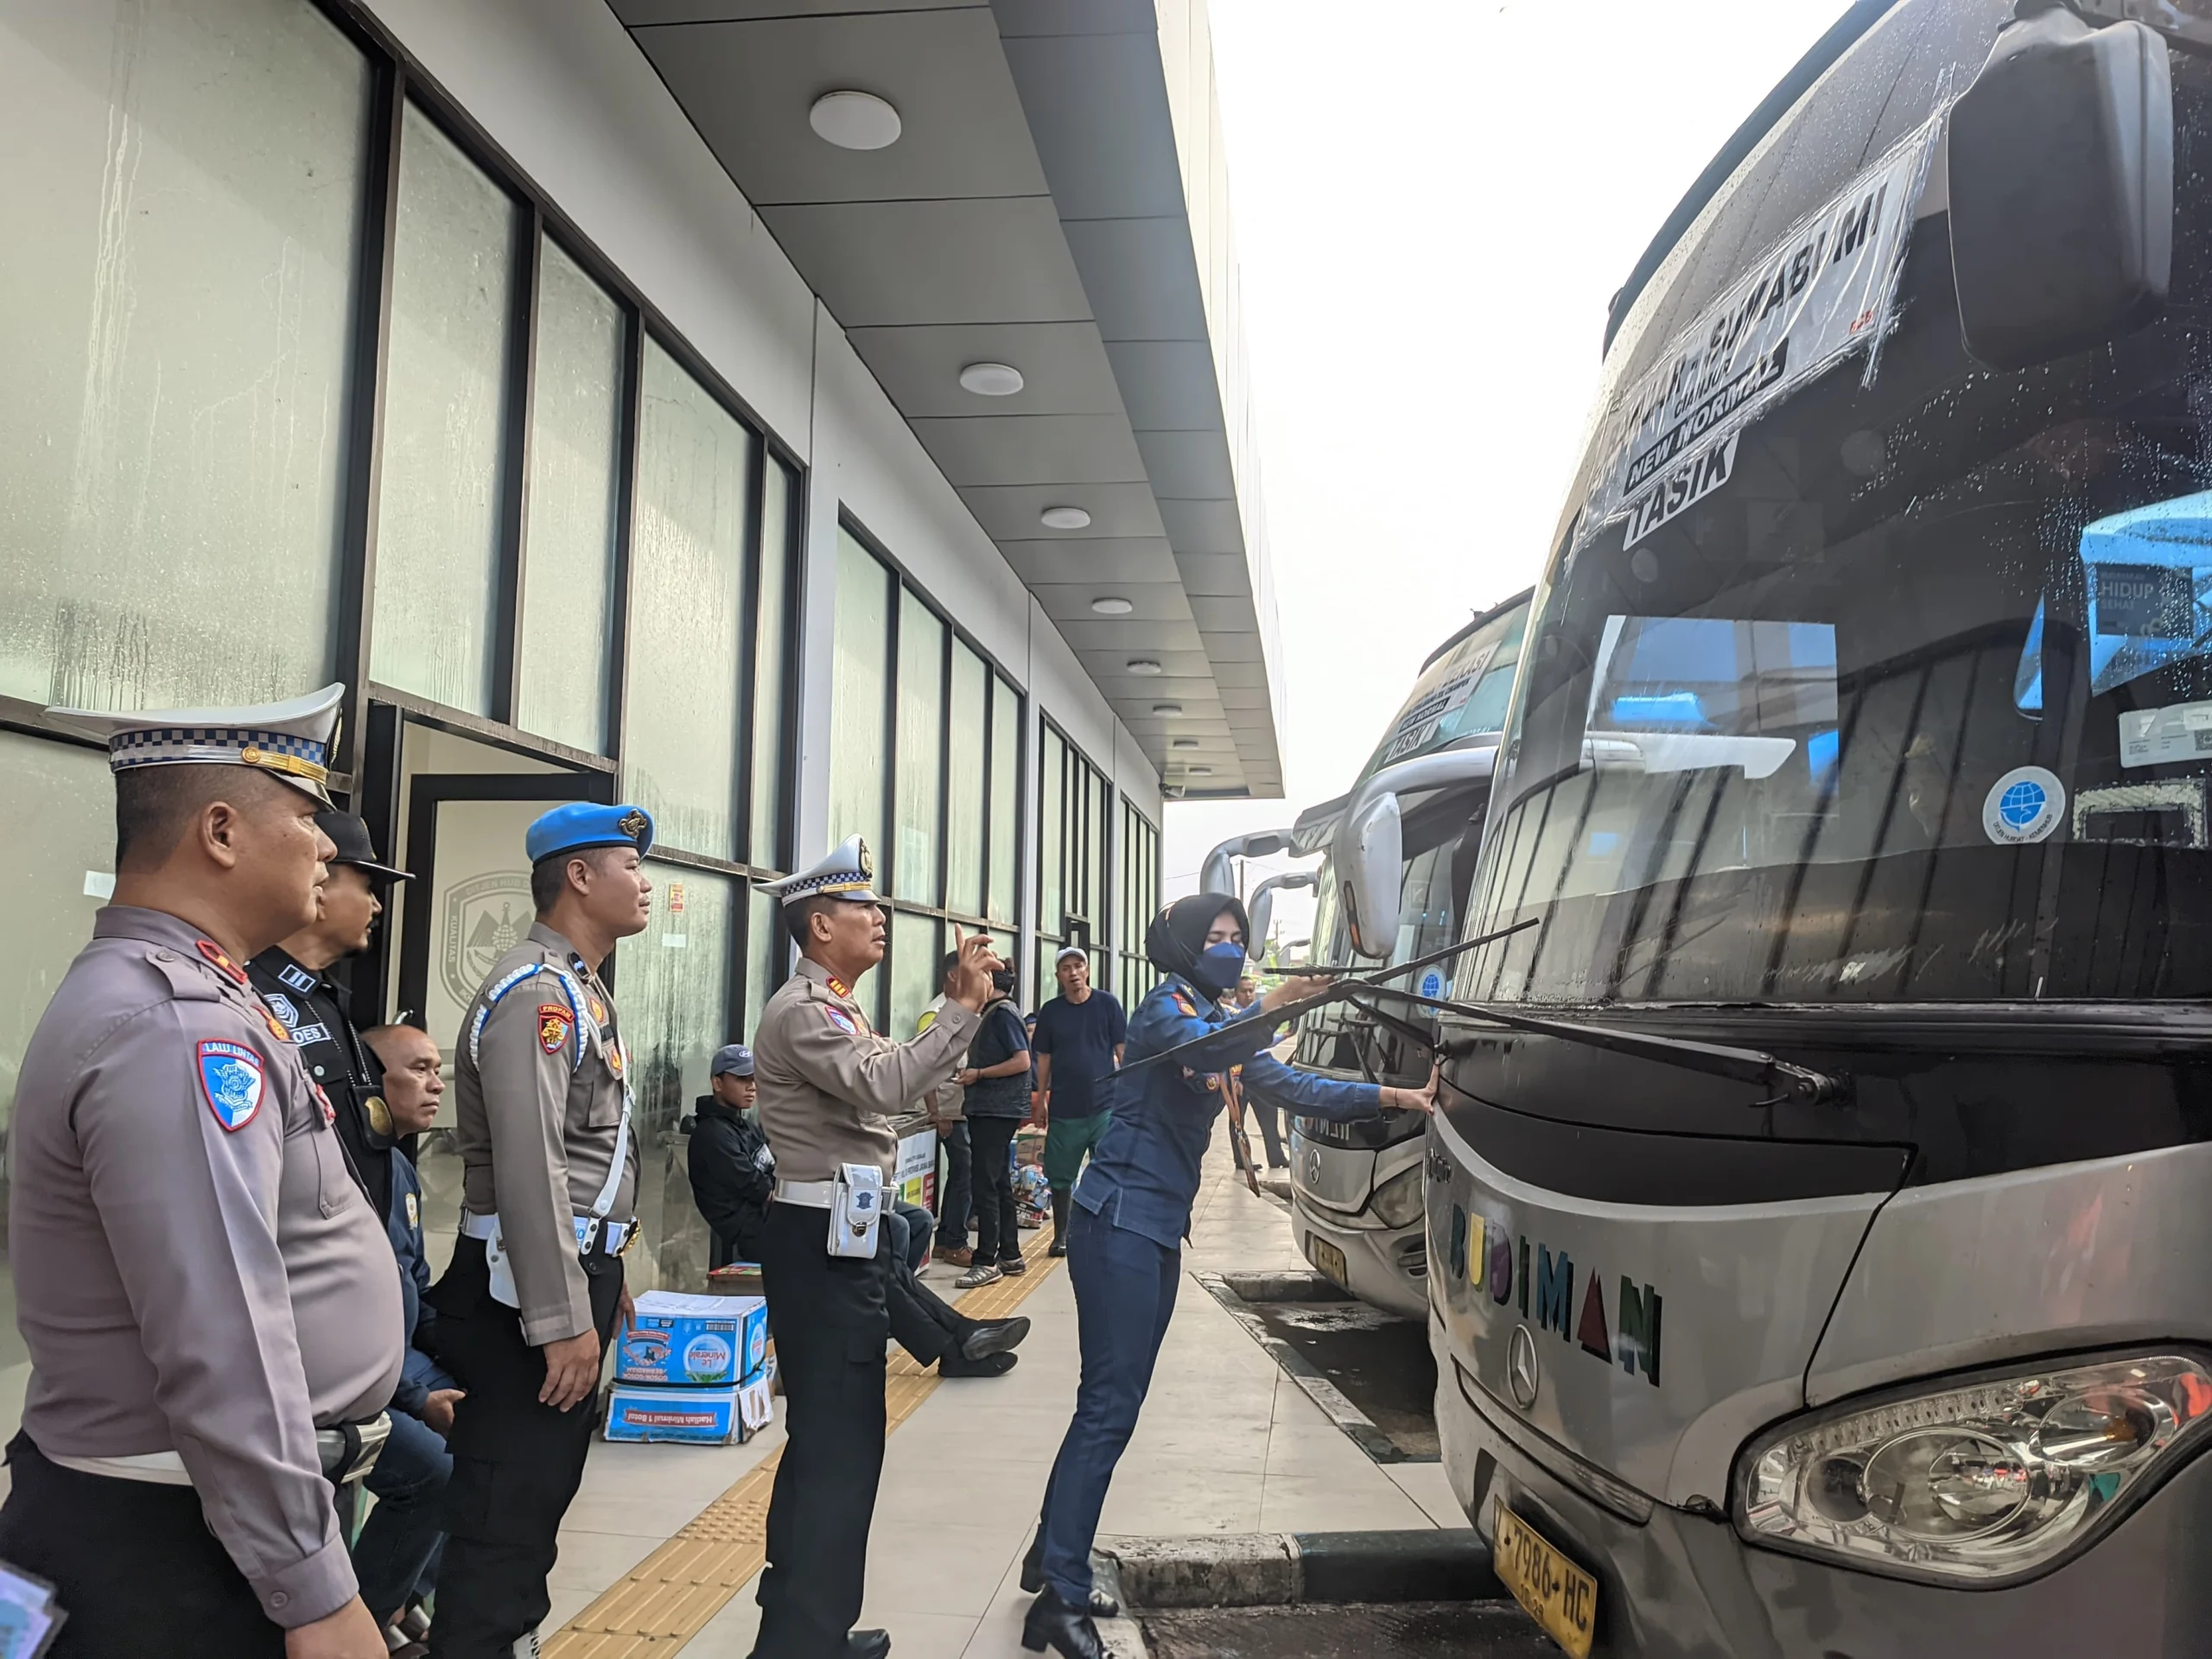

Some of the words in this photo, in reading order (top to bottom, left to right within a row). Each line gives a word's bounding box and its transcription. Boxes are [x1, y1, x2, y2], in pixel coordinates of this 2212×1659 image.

[1629, 435, 1675, 489] NEW
[1630, 437, 1732, 542] TASIK
[2101, 581, 2154, 599] HIDUP
[448, 914, 458, 963] KUALITAS
[542, 1006, 571, 1019] PROPAM
[204, 1042, 231, 1053] LALU
[232, 1046, 261, 1066] LINTAS
[1450, 1203, 1662, 1389] BUDIMAN
[689, 1351, 727, 1361] Minerale
[701, 1359, 712, 1368] Le
[627, 1411, 647, 1422] Botol
[648, 1412, 652, 1423] 1
[654, 1411, 685, 1423] Minimal
[685, 1412, 713, 1424] Hadiah
[1514, 1523, 1552, 1599] 7986
[1563, 1568, 1590, 1632] HC
